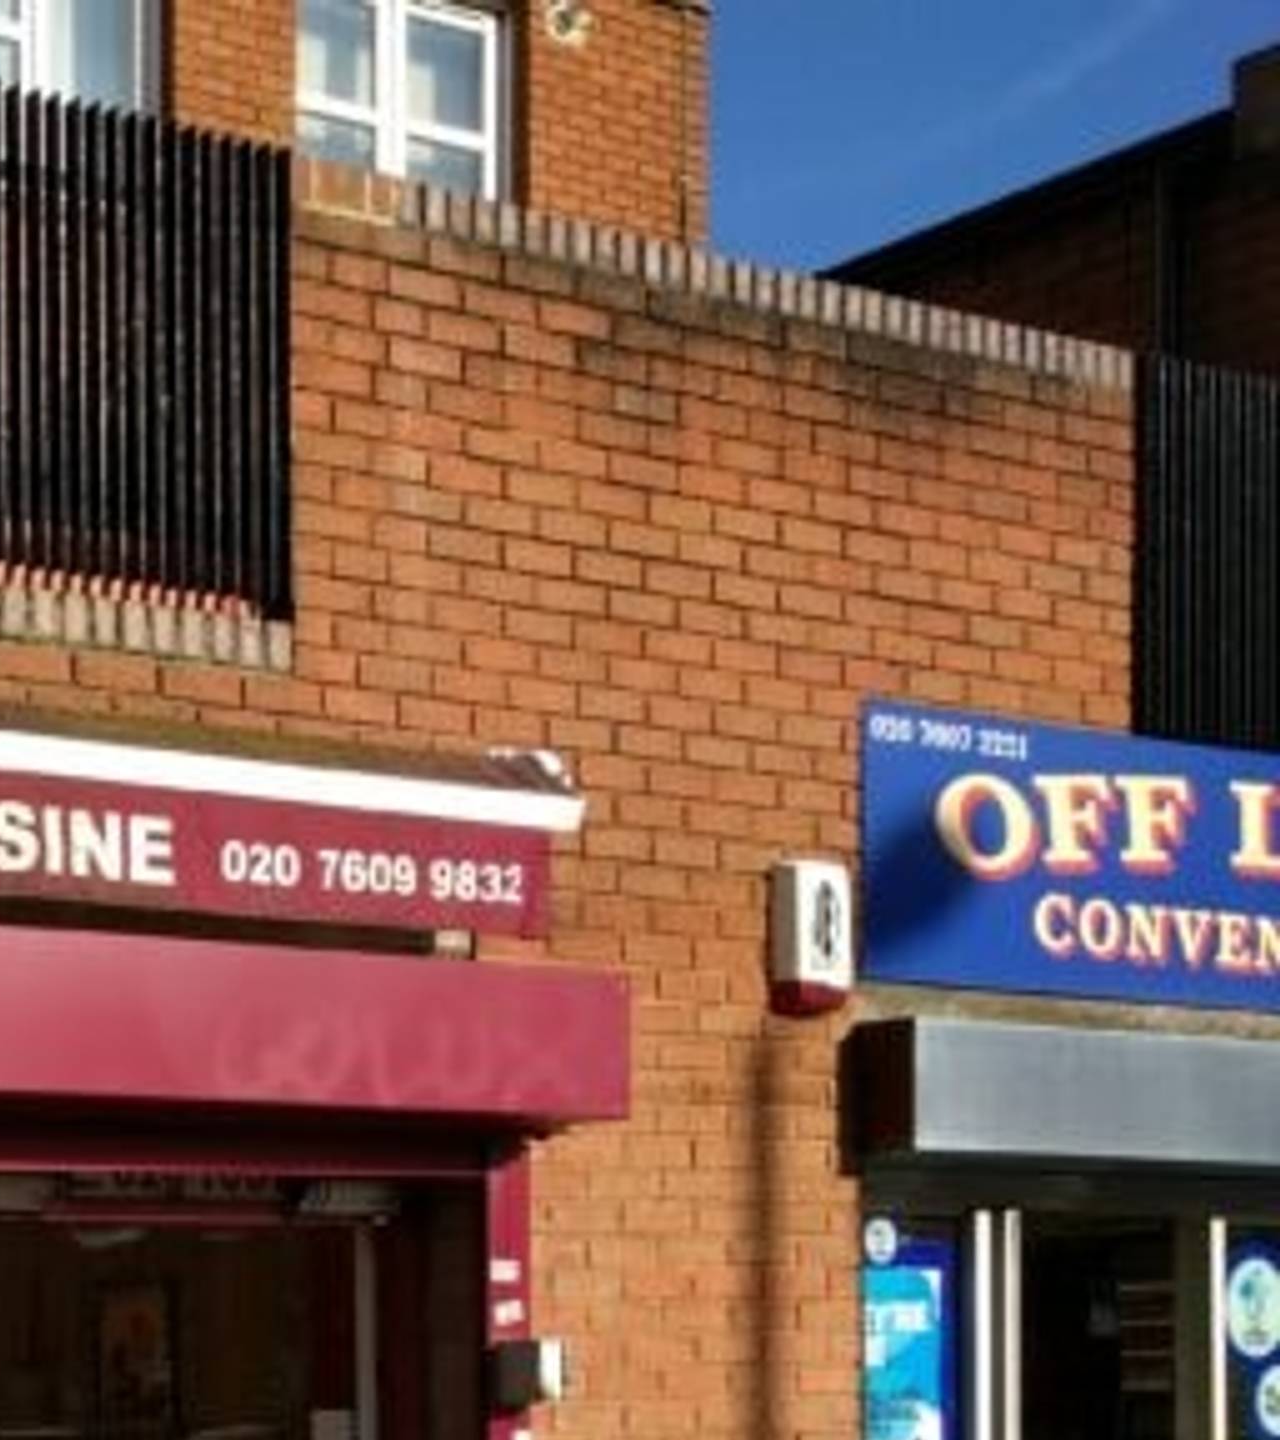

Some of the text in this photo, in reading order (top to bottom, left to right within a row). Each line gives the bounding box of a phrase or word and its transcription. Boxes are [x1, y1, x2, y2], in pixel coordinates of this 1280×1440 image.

[936, 772, 1197, 881] OFF
[219, 840, 302, 887] 020
[318, 849, 417, 897] 7609
[428, 859, 524, 905] 9832
